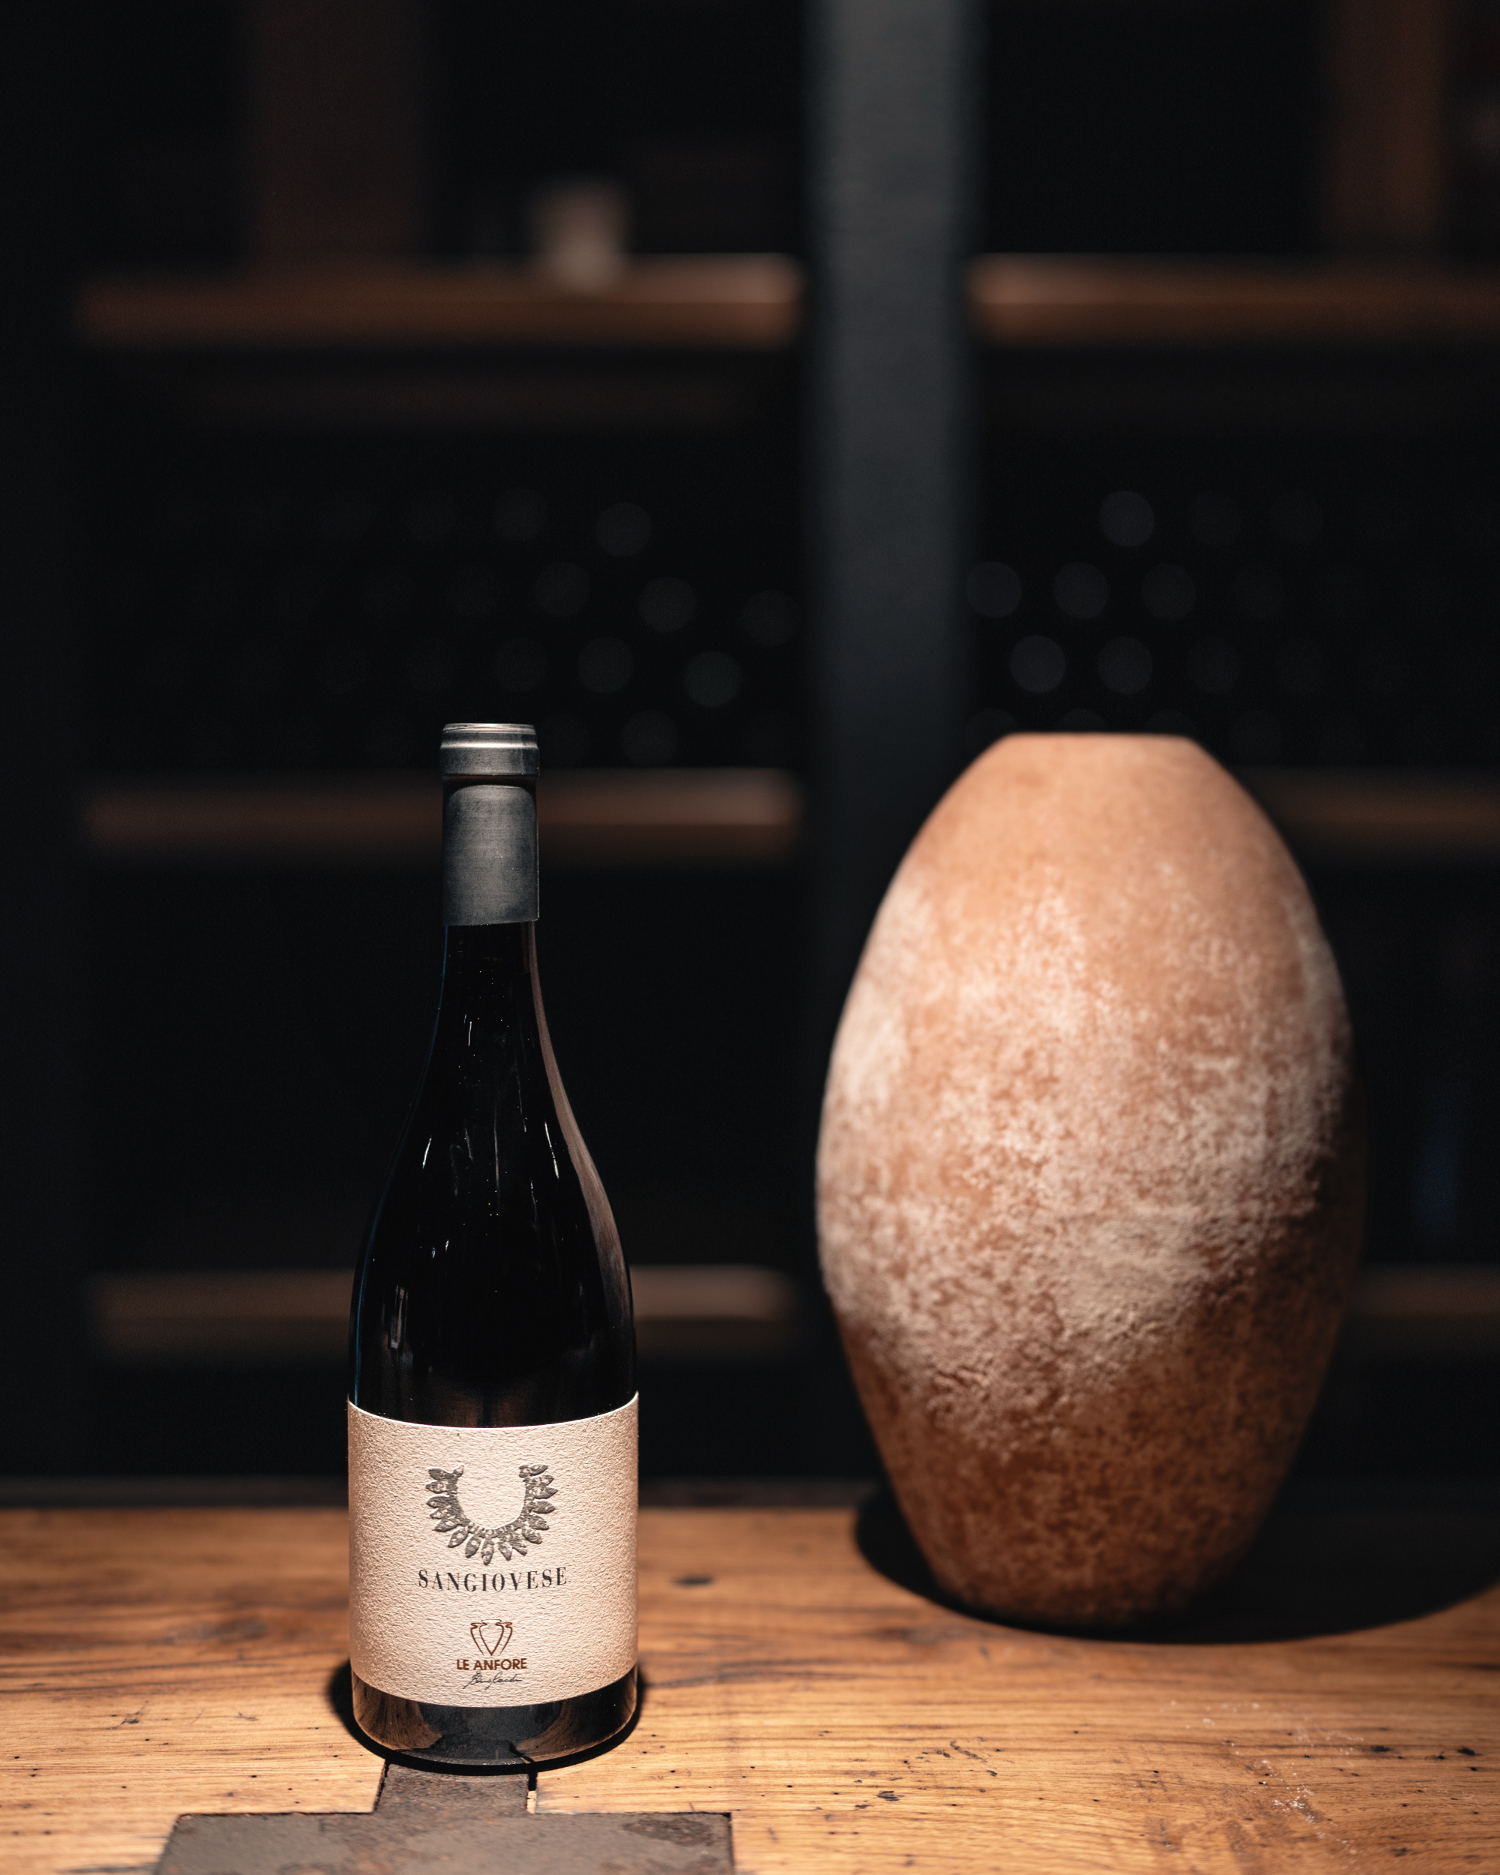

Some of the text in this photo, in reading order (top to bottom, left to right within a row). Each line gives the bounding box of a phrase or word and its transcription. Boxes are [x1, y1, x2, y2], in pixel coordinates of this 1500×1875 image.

[418, 1566, 567, 1592] SANGIOVESE
[456, 1658, 527, 1671] LE ANFORE
